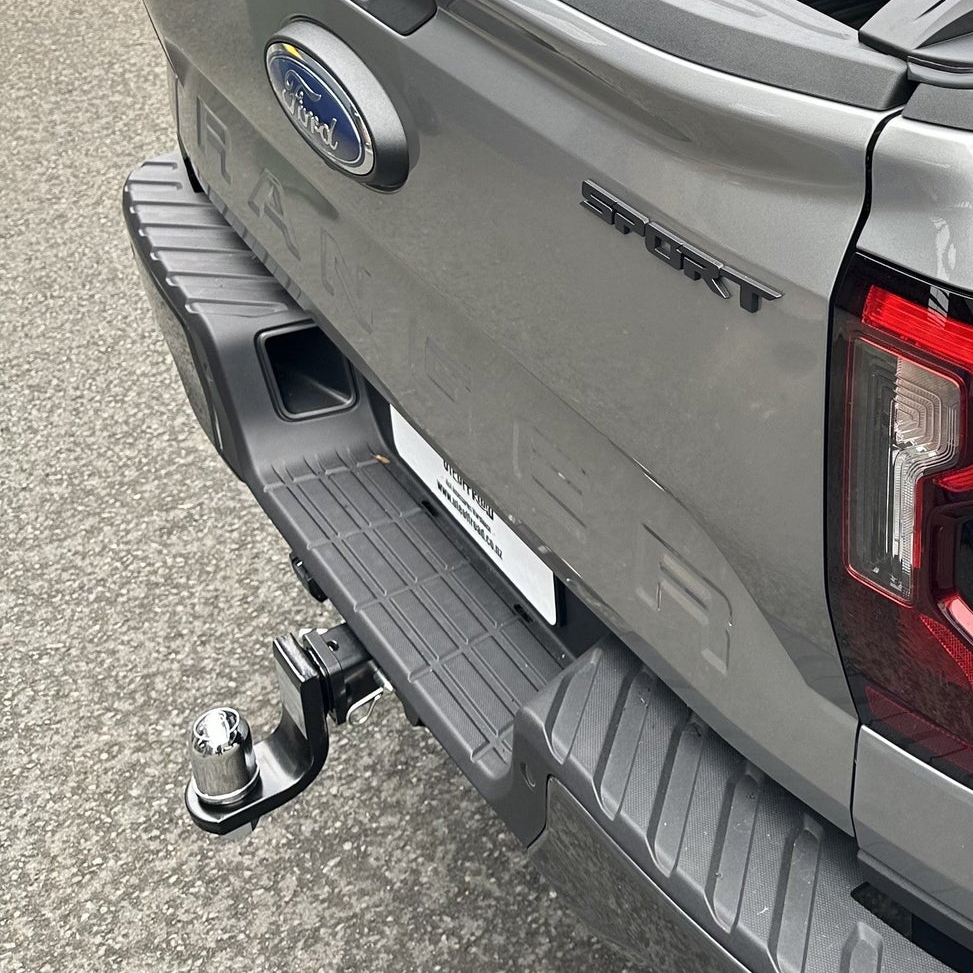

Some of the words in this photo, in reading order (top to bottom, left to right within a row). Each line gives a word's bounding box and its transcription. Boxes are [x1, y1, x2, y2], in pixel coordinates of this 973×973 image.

[283, 69, 339, 151] Ford
[579, 179, 784, 314] SPORT
[197, 93, 732, 673] RANGER
